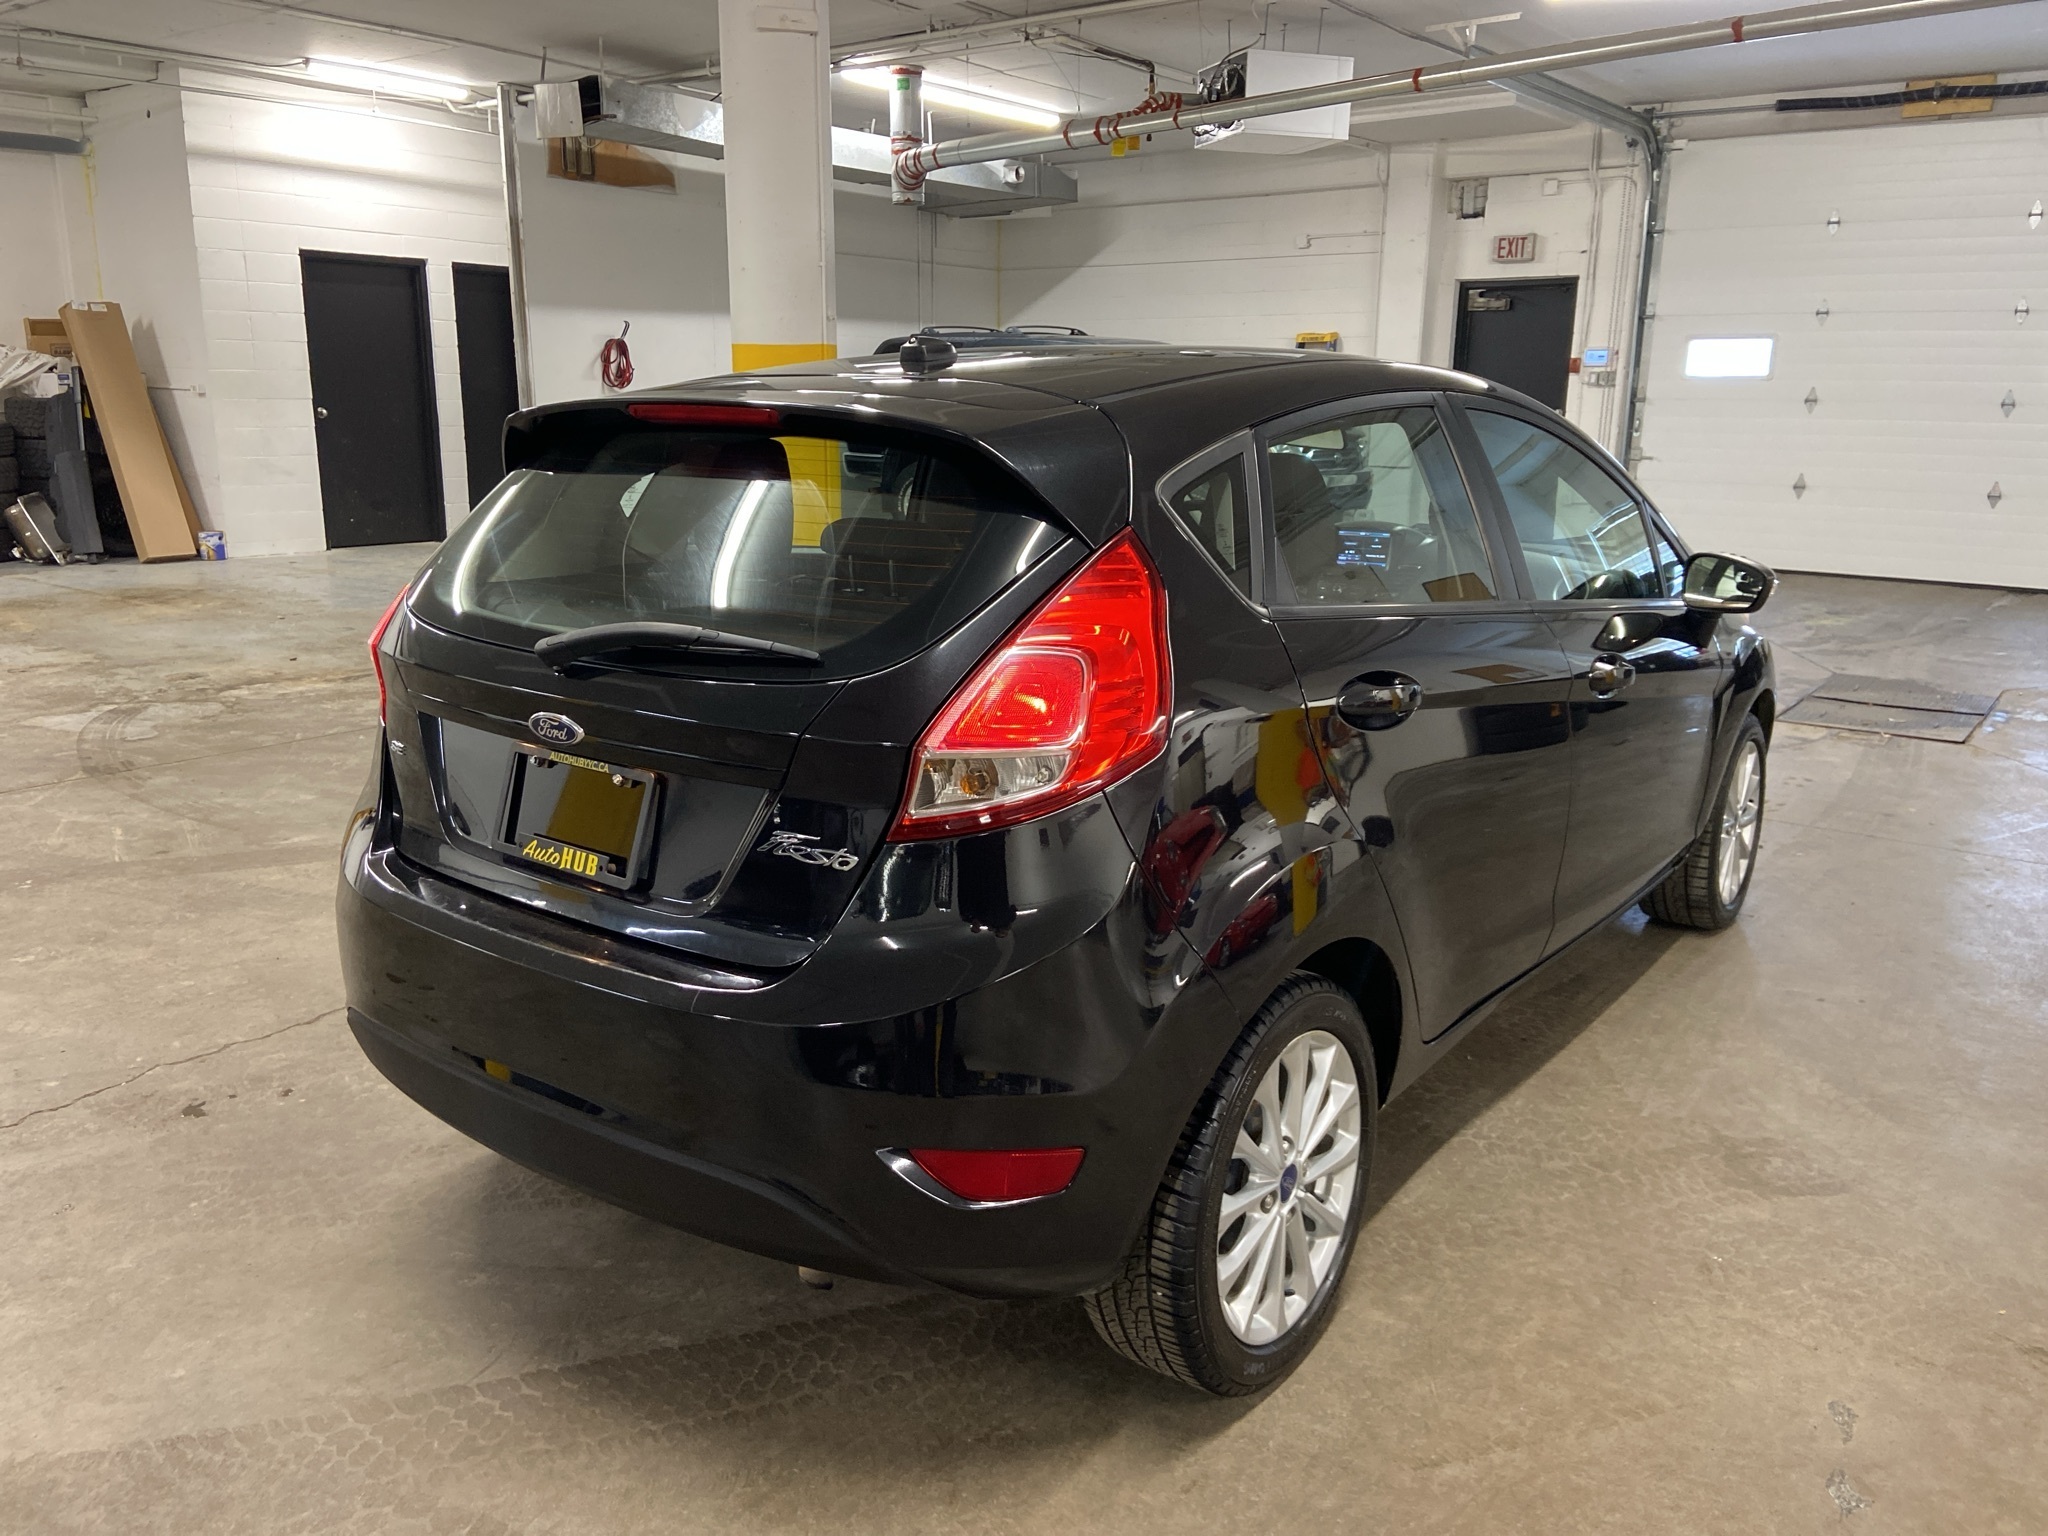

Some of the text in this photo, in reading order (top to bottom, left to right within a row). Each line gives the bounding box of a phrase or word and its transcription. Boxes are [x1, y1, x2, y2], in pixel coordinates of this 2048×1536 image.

[1497, 236, 1528, 258] EXIT
[538, 718, 567, 740] Ford
[549, 751, 609, 773] AUTOHUBYYC.CA
